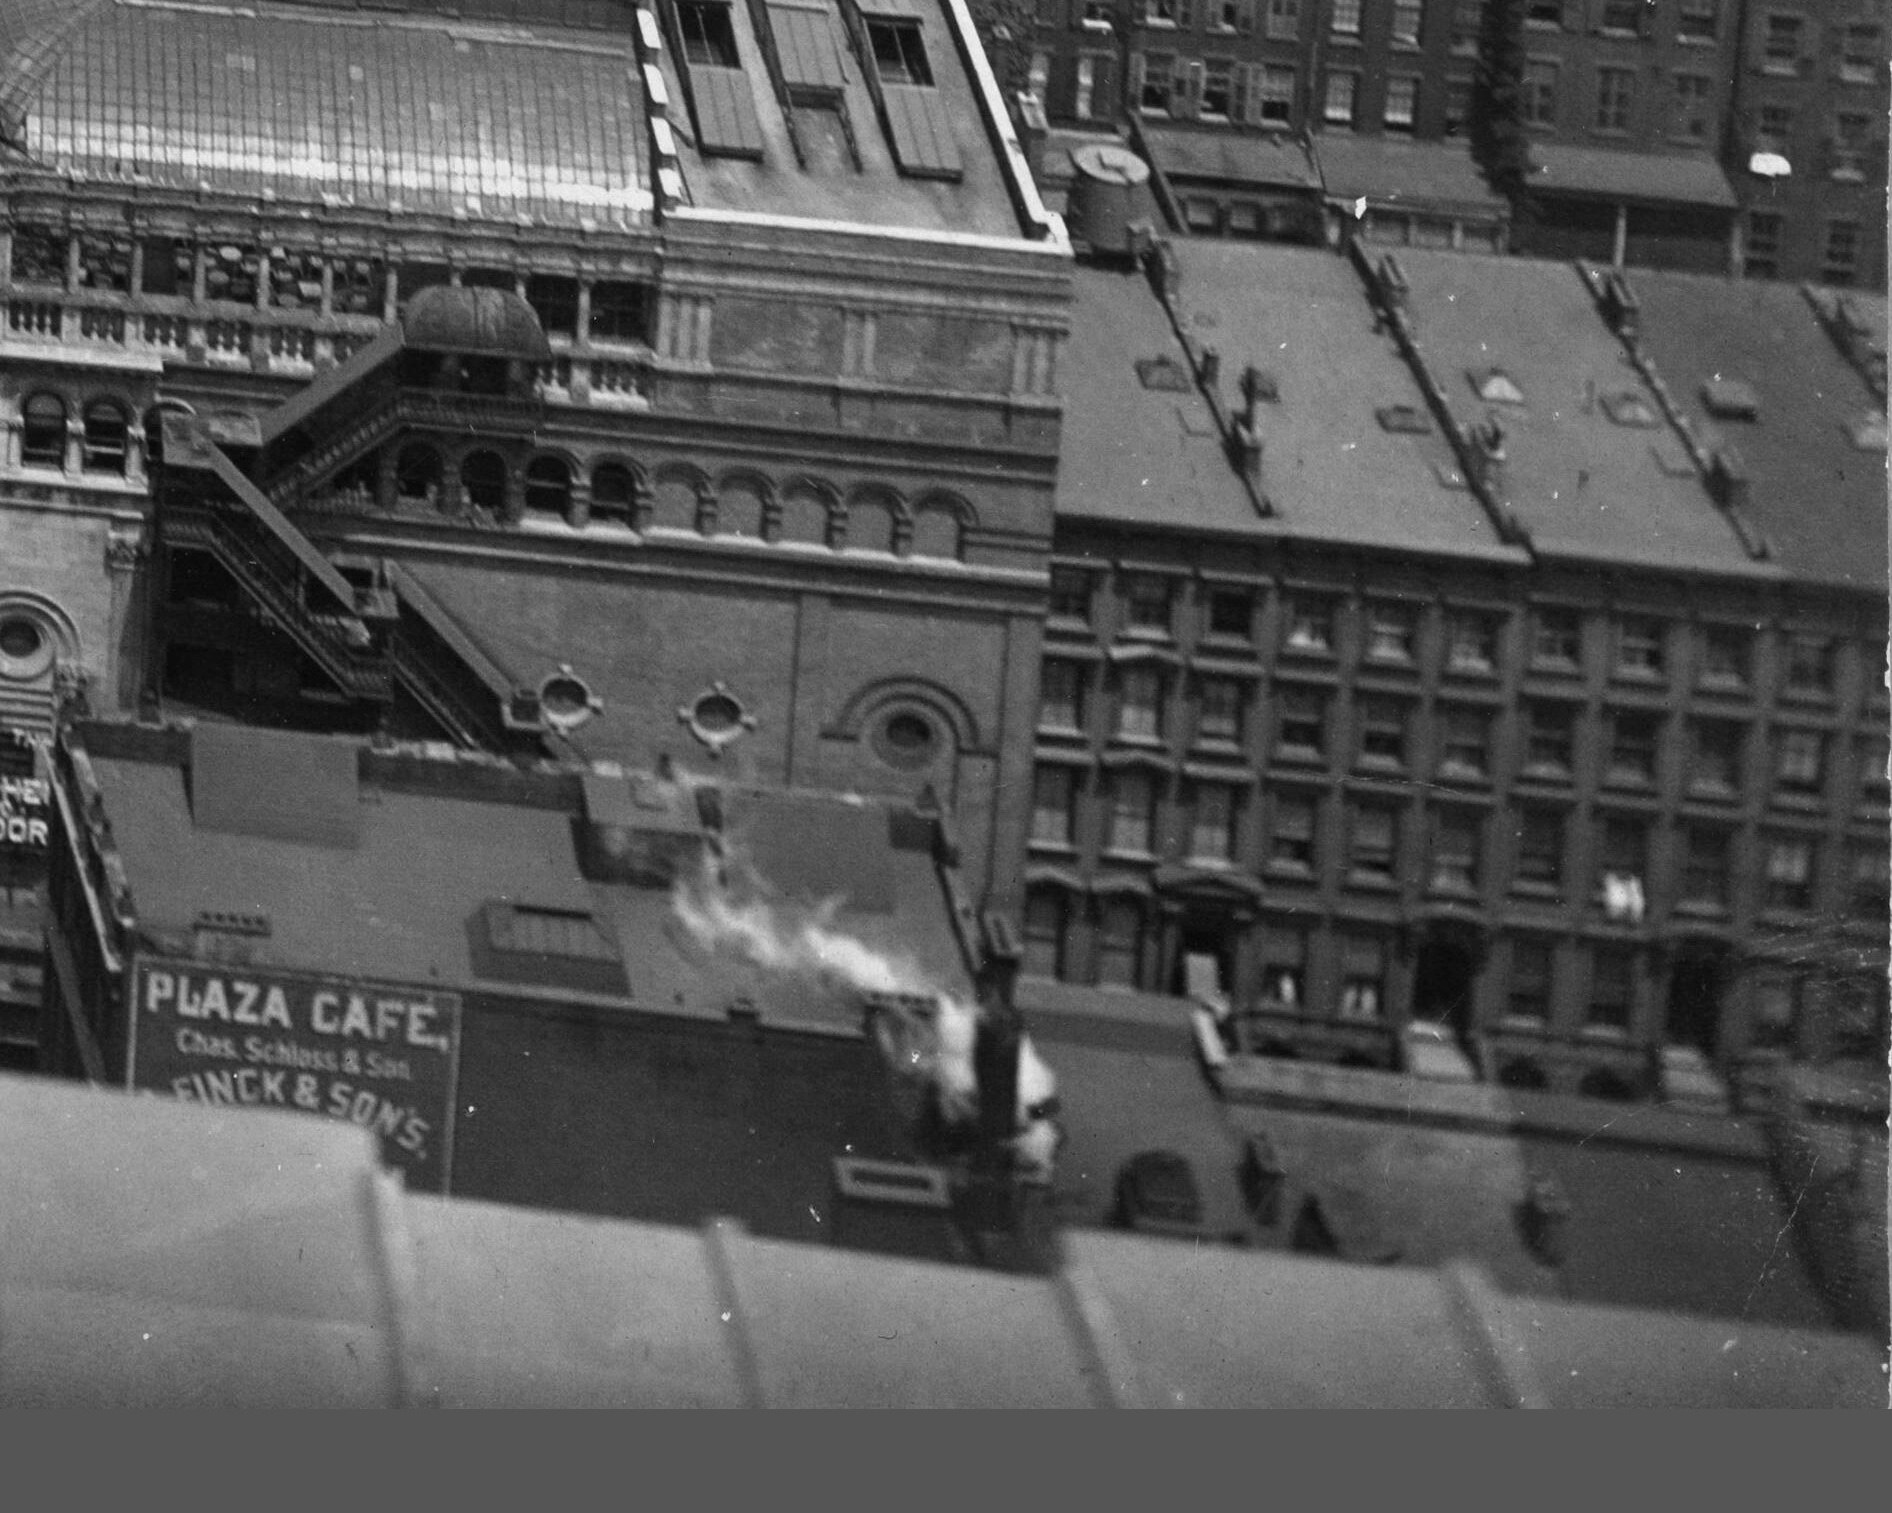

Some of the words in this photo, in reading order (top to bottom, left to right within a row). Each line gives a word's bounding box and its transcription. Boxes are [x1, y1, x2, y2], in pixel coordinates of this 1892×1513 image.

[145, 972, 293, 1029] PLAZA
[342, 1049, 361, 1075] &
[295, 1074, 320, 1109] &
